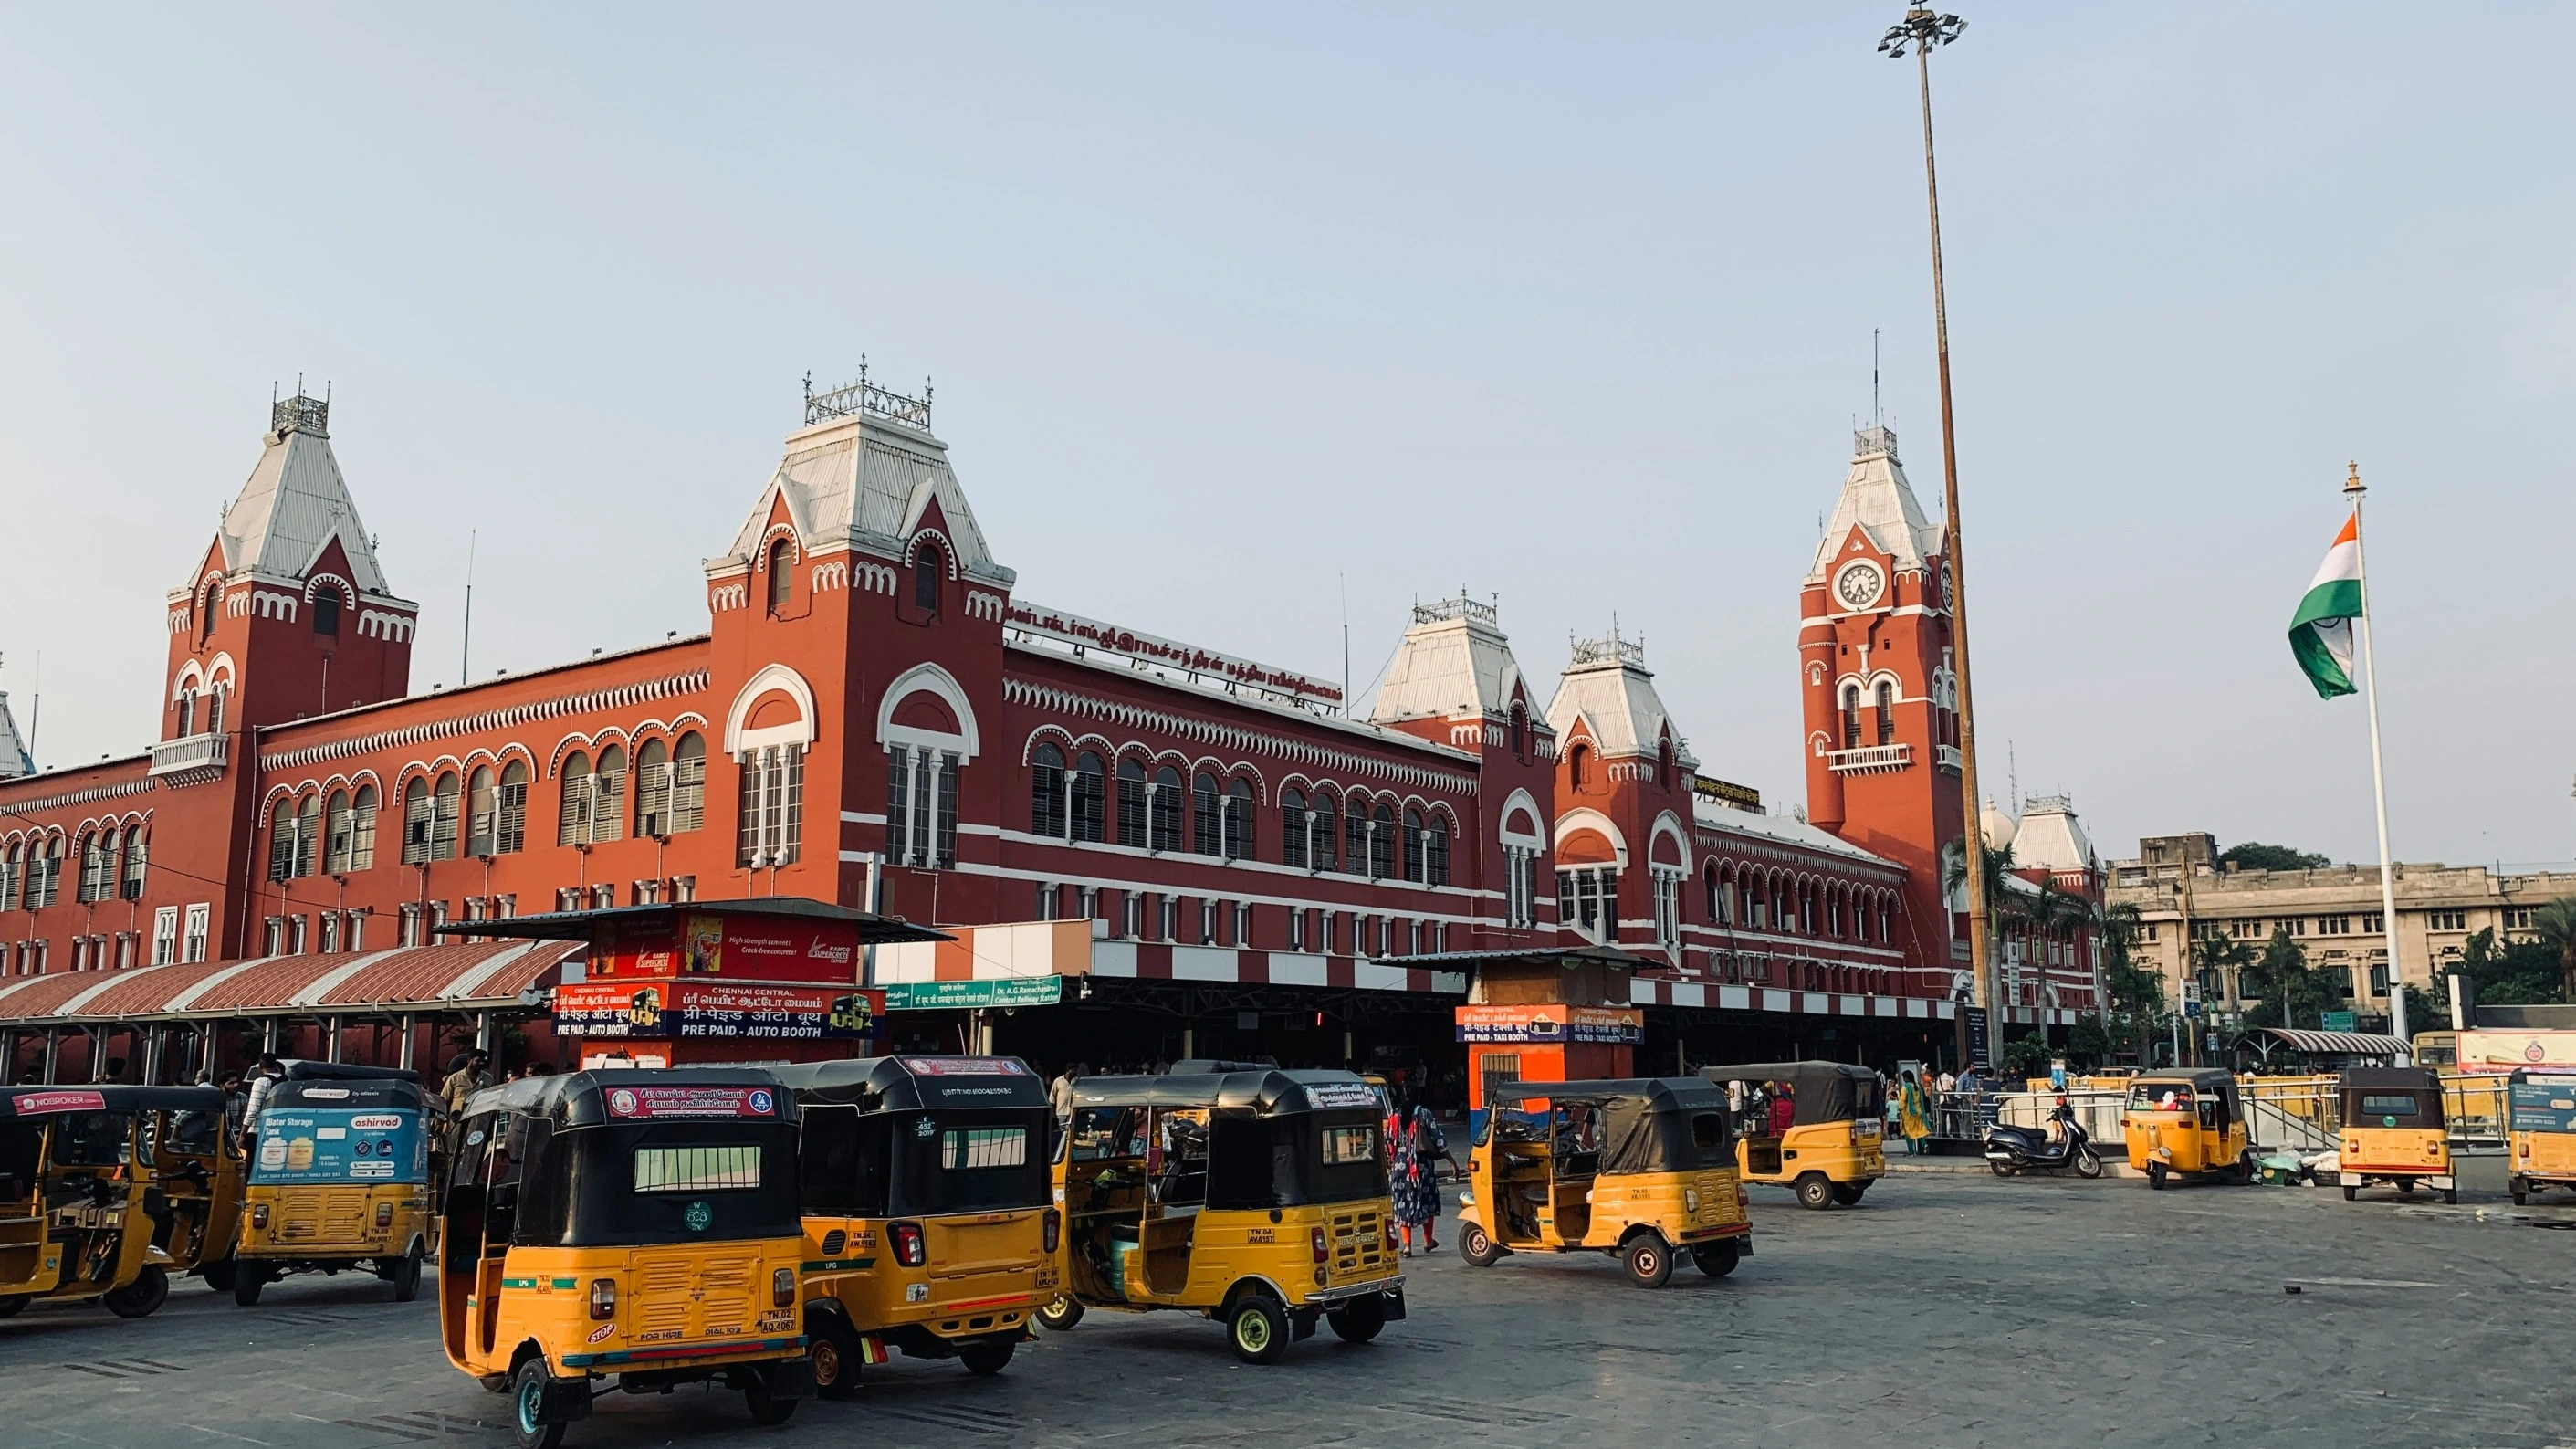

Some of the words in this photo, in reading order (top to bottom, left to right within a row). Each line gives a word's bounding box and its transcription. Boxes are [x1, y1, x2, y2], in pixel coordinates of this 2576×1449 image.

[729, 937, 743, 945] High
[712, 987, 752, 995] CHENNAI
[754, 988, 795, 996] CENTRAL
[700, 993, 736, 1005] பெயிட்
[738, 995, 781, 1008] ஆட்டோ
[784, 997, 822, 1008] மையம்
[1017, 996, 1039, 1004] Railway
[797, 1011, 822, 1025] बूथ
[557, 1024, 570, 1035] PRE
[571, 1024, 584, 1035] PAID
[588, 1024, 606, 1034] AUTO
[606, 1024, 629, 1035] BOOTH
[681, 1024, 707, 1035] PRE
[708, 1024, 737, 1036] PAID
[746, 1026, 779, 1036] AUTO
[781, 1027, 822, 1037] BOOTH
[36, 1097, 84, 1107] NOBROKER
[266, 1118, 287, 1127] Water
[287, 1118, 313, 1127] Storage
[355, 1118, 398, 1127] ashirvad
[266, 1127, 280, 1136] Tank
[687, 1211, 707, 1222] 828
[767, 1310, 791, 1319] TN.02
[762, 1322, 795, 1332] AQ.4062
[590, 1325, 613, 1342] STOP
[663, 1331, 683, 1339] HIRE
